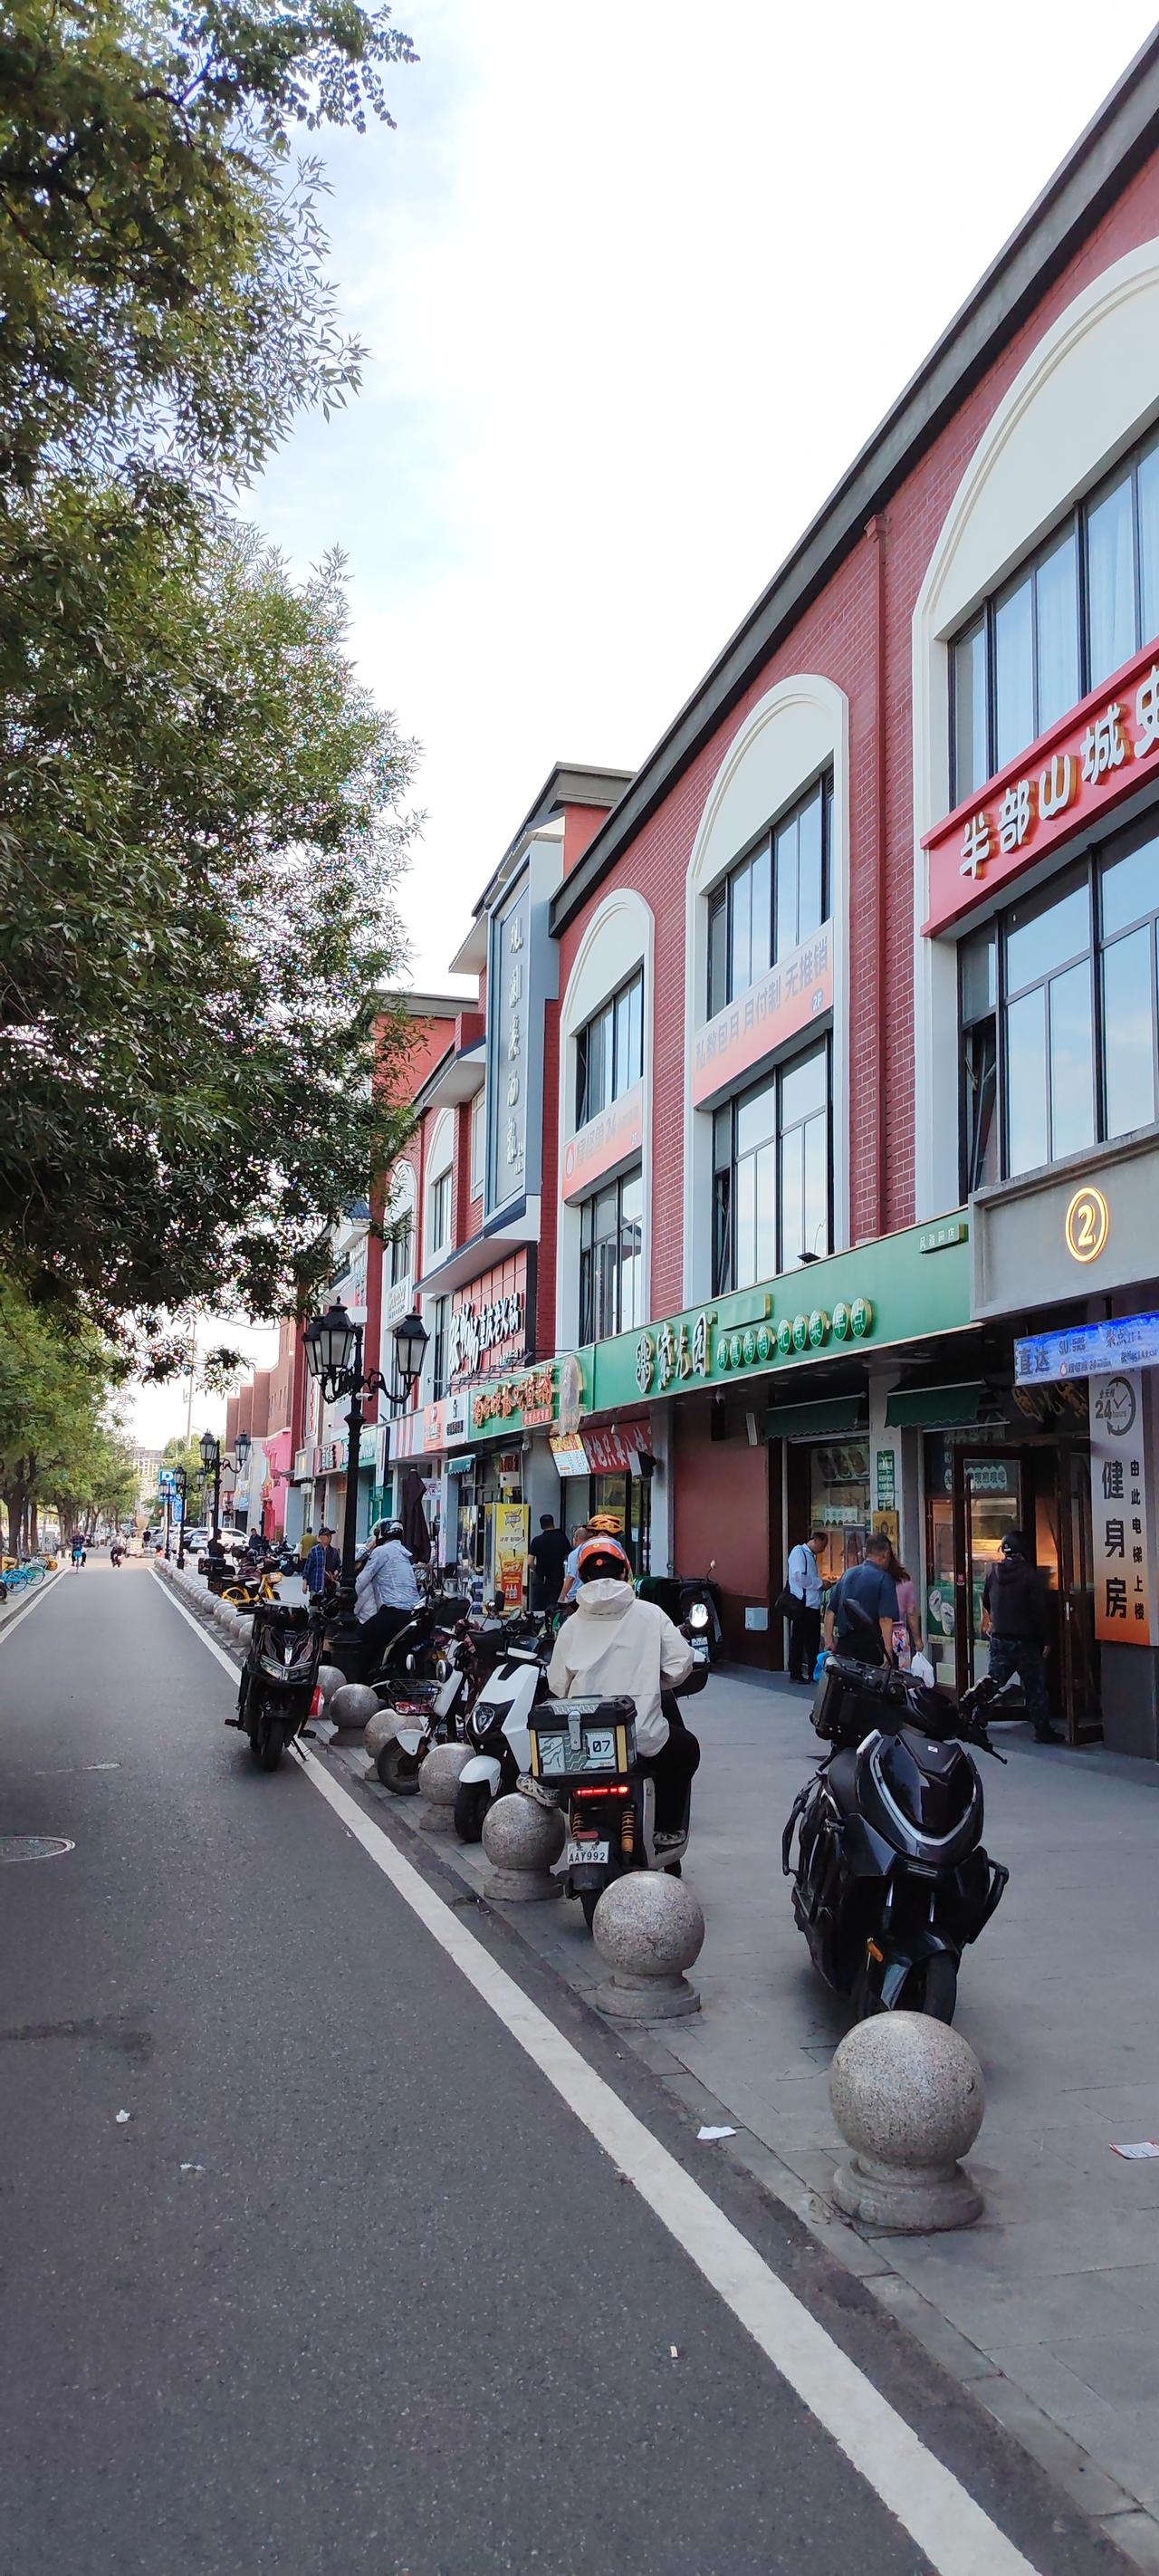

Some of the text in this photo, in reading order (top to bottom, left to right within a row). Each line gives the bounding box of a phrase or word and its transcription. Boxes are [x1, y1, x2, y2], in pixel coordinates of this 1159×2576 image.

[656, 1311, 710, 1390] 紫光园
[1019, 1346, 1051, 1376] 直达
[1095, 1399, 1112, 1420] 24
[1102, 1460, 1127, 1619] 健身房
[1130, 1459, 1145, 1620] 由此电梯上楼
[593, 1740, 610, 1753] 07
[570, 1851, 606, 1862] AAY992
